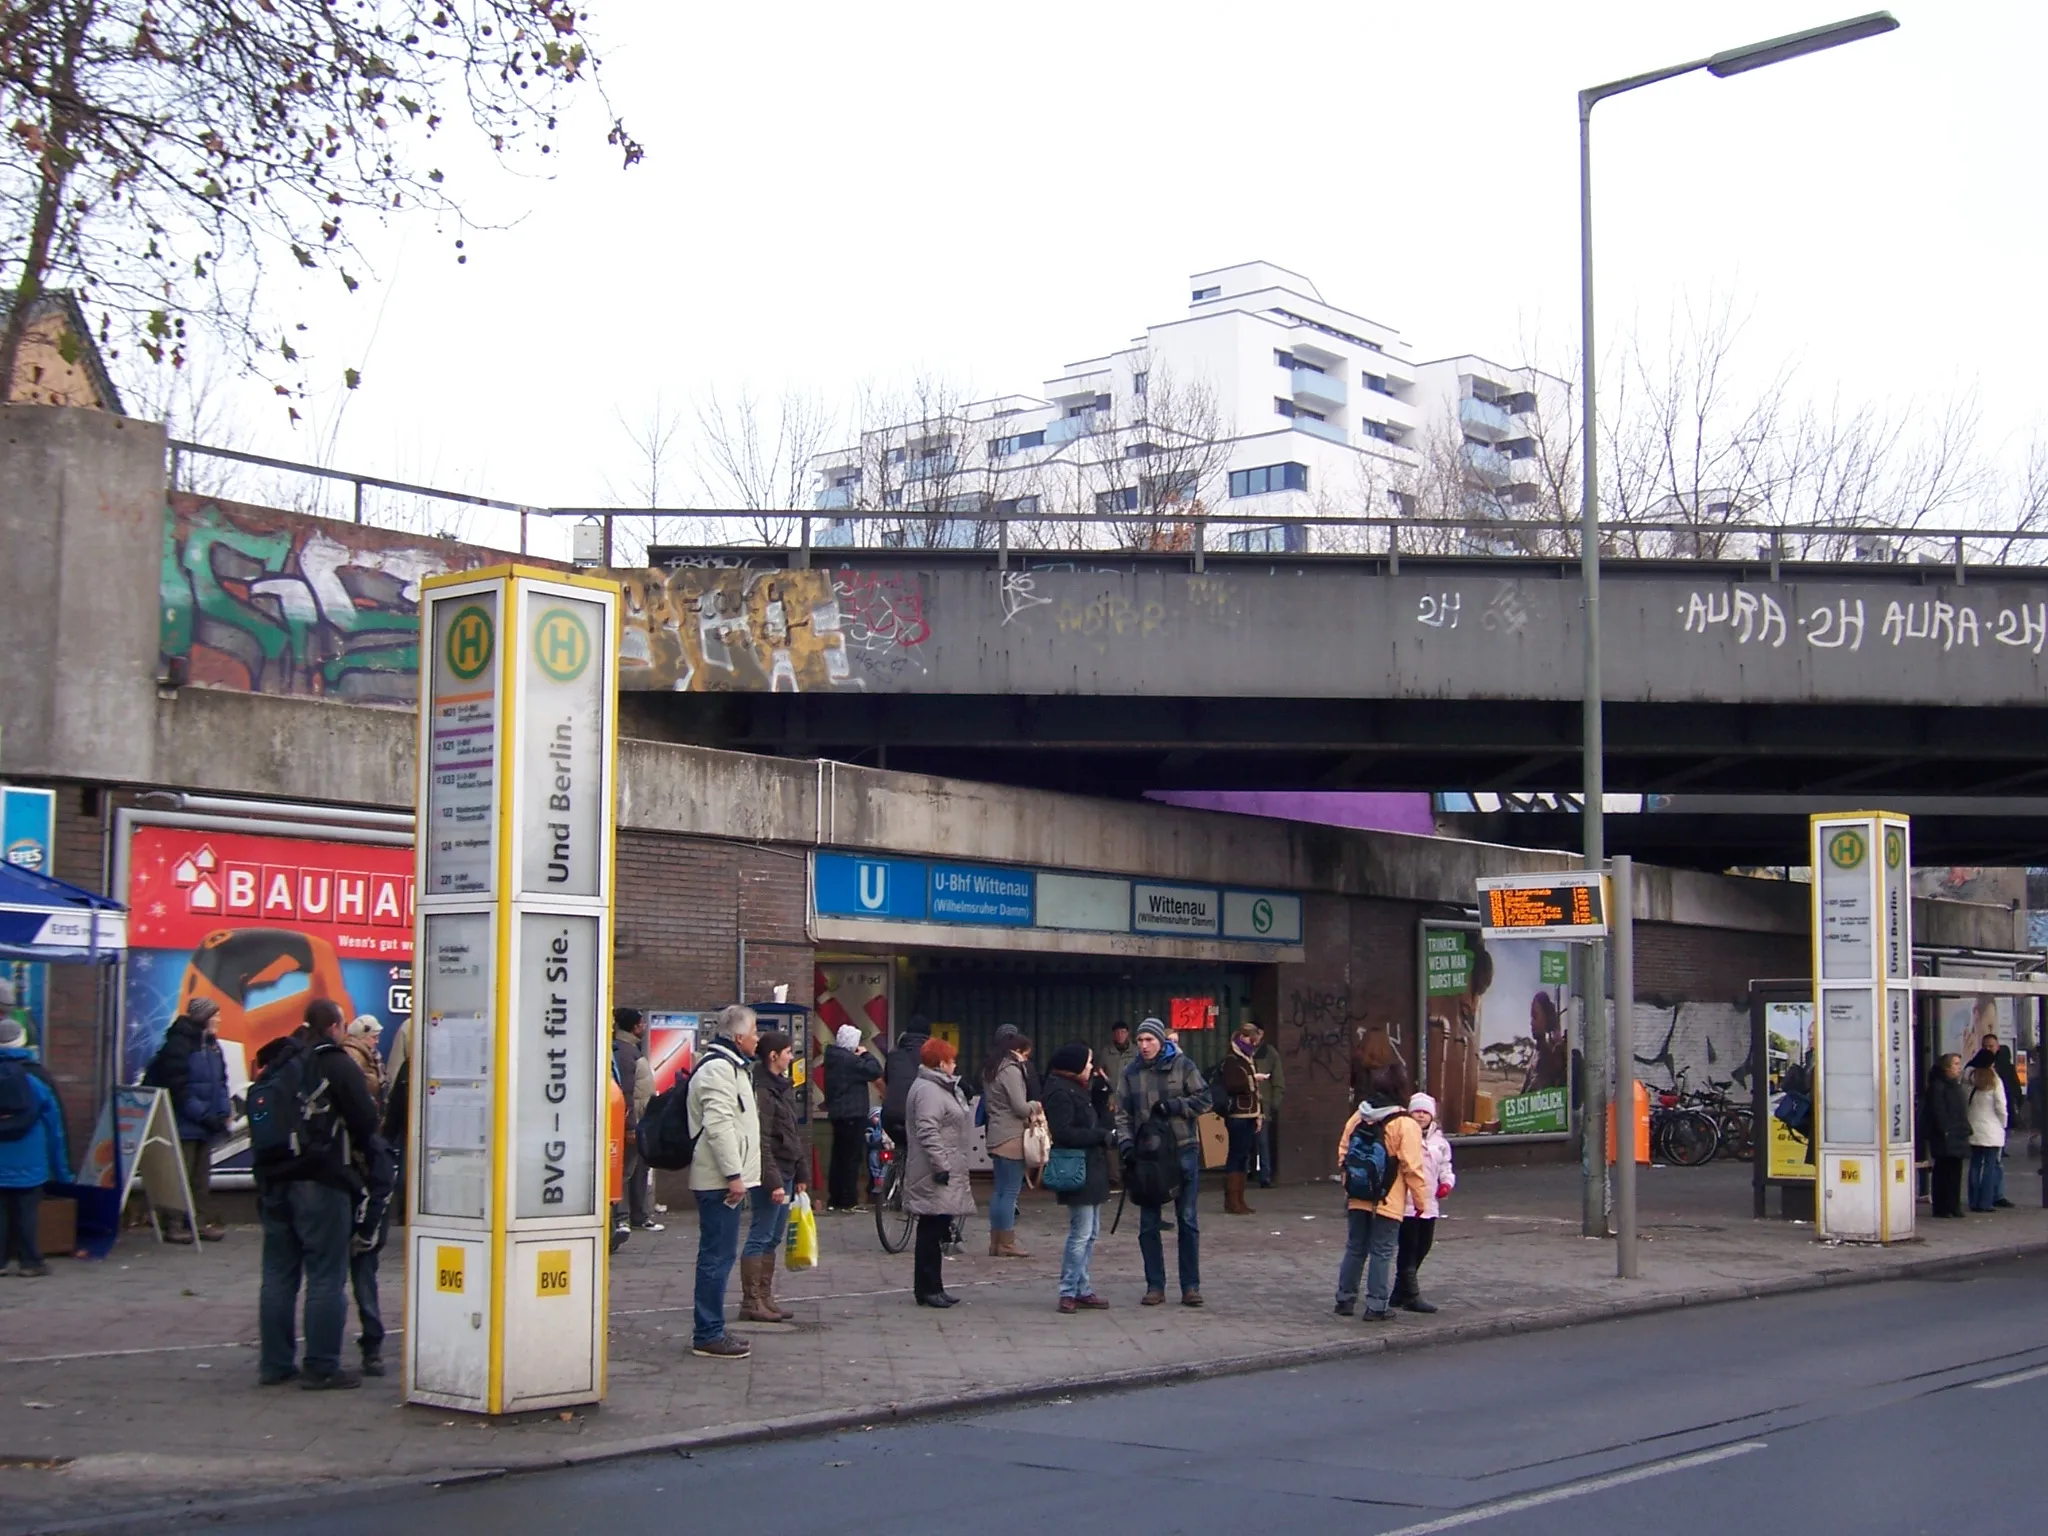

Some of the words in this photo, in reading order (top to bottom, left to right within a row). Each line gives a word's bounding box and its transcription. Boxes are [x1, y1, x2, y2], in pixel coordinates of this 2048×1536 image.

[459, 621, 482, 665] H
[550, 623, 577, 667] H
[549, 715, 573, 812] Berlin.
[8, 848, 43, 865] EFES
[547, 822, 570, 883] Und
[1838, 839, 1855, 861] H
[859, 864, 885, 910] U
[935, 872, 971, 893] U-Bhf
[974, 876, 1029, 897] Wittenau
[933, 898, 998, 916] (Wilhelmsruher
[1000, 900, 1030, 920] Damm)
[1149, 895, 1206, 916] Wittenau
[1138, 913, 1190, 926] (Wilhelmsruher
[1191, 916, 1216, 929] Damm)
[338, 934, 376, 949] Wenn's
[380, 938, 398, 952] gut
[1428, 937, 1458, 952] TRINKEN,
[545, 929, 569, 983] Sie.
[1429, 955, 1449, 970] WENN
[1450, 954, 1467, 969] MAN
[1429, 973, 1451, 989] DURST
[544, 993, 567, 1039] für
[545, 1048, 567, 1104] Gut
[1505, 1099, 1516, 1117] ES
[1517, 1097, 1529, 1115] IST
[541, 1139, 566, 1205] BVG
[1841, 1169, 1859, 1180] BVG
[440, 1269, 463, 1289] BVG
[541, 1270, 568, 1289] BVG
